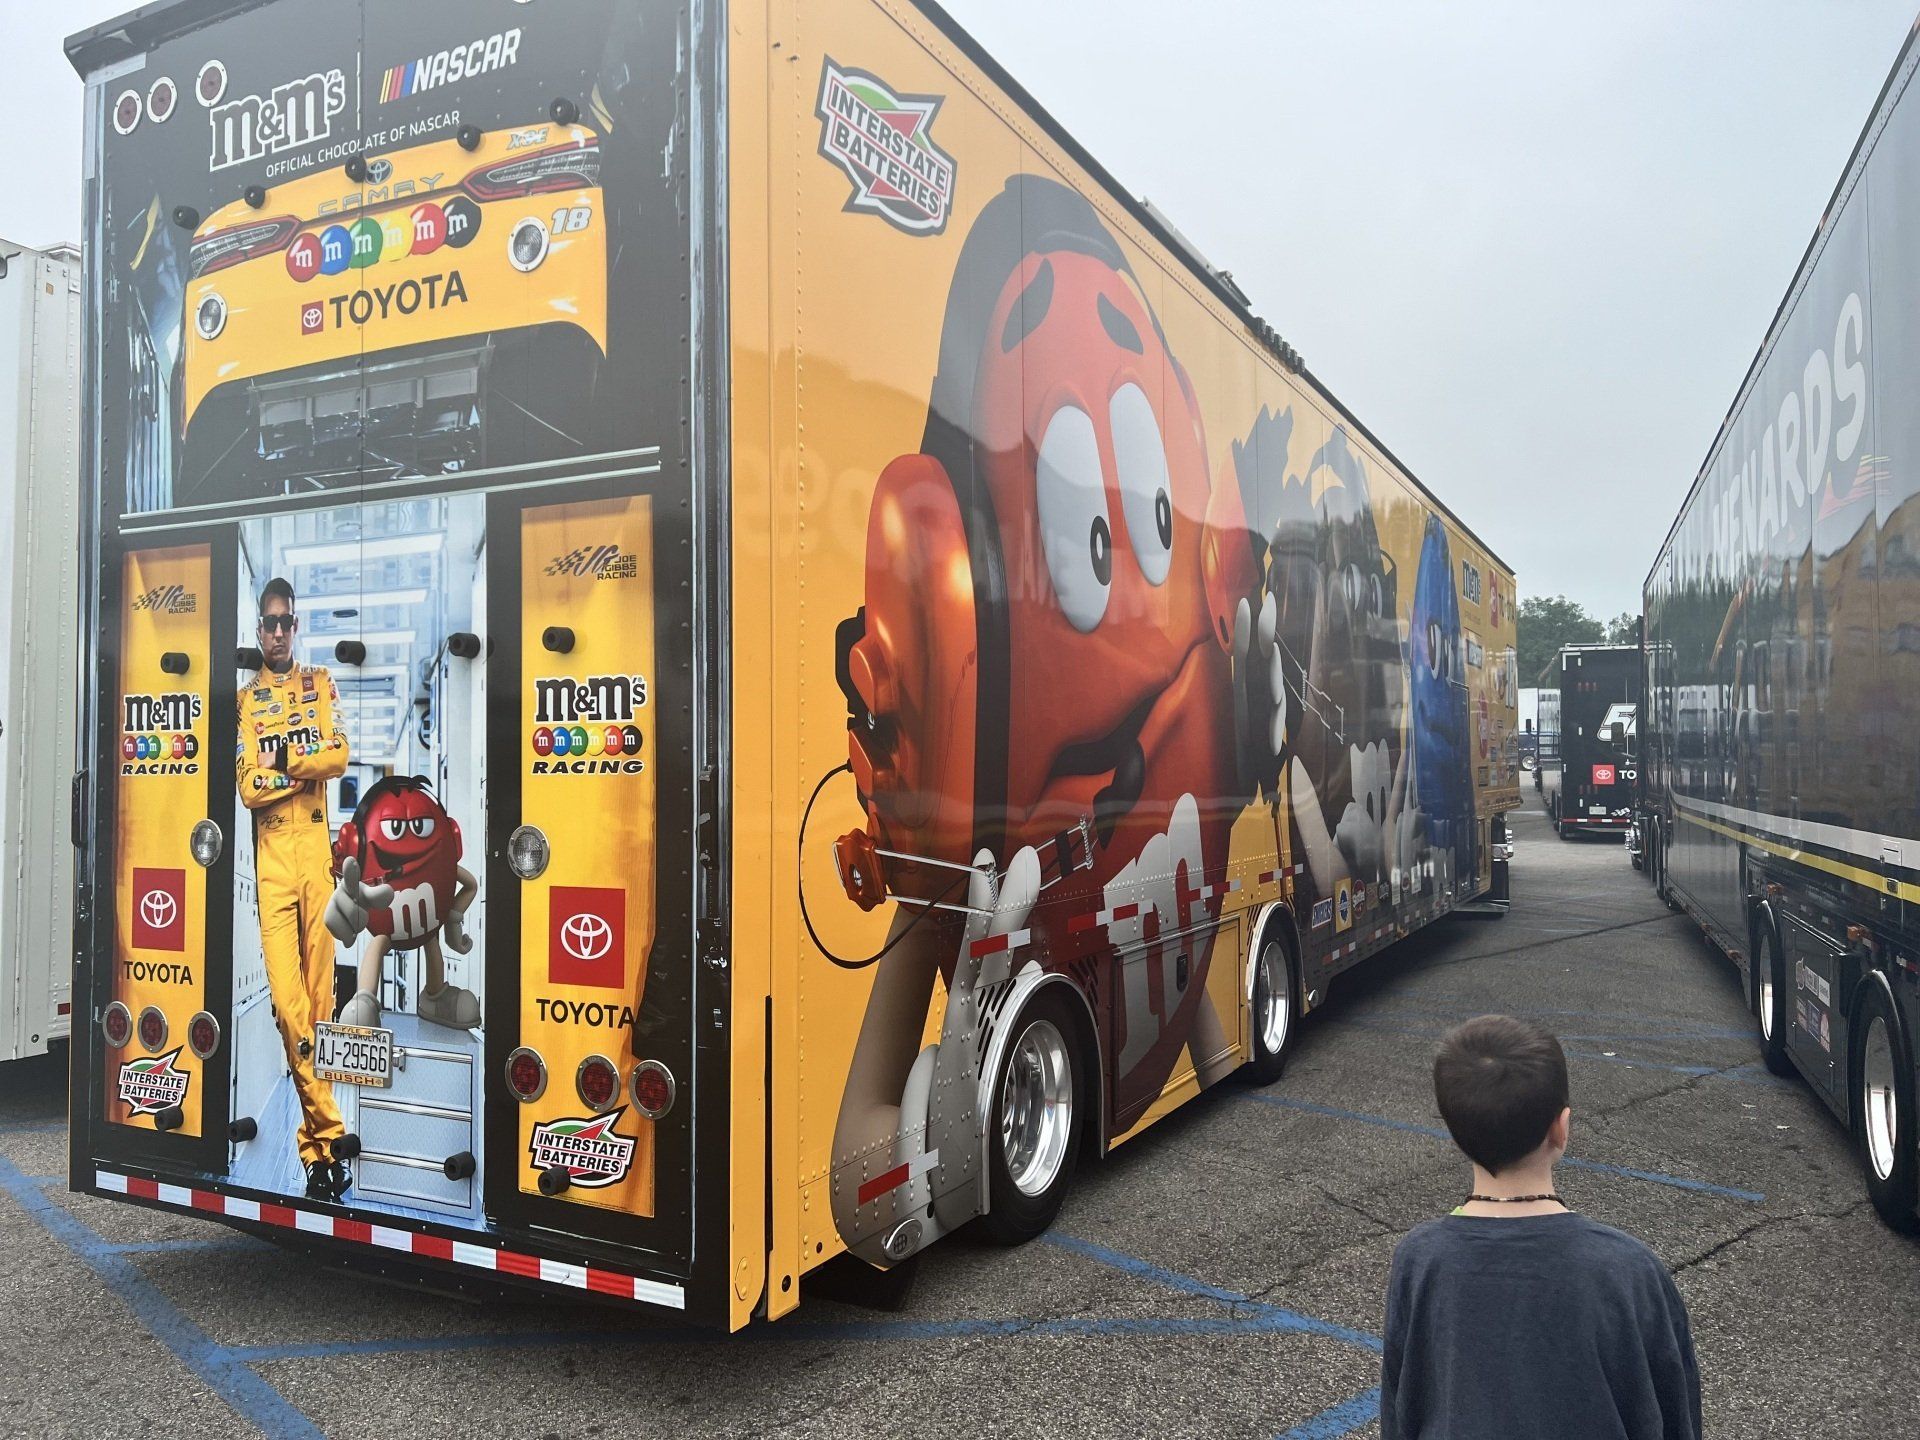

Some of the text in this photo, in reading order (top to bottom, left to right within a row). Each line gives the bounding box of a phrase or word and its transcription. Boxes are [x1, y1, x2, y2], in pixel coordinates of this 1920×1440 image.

[411, 28, 521, 94] NASCAR
[266, 110, 460, 177] OFFICIAL CHOCOLATE OF NASCAR
[831, 85, 947, 190] INTERSTATE
[835, 120, 939, 215] BATTERIES
[318, 173, 444, 216] CAMRY
[551, 206, 592, 235] 18
[329, 270, 468, 328] TOYOTA
[1712, 292, 1866, 560] MENARDS
[604, 563, 637, 572] GIBBS
[614, 554, 637, 563] JOE
[597, 571, 637, 580] RACING
[122, 763, 198, 775] RACING
[532, 760, 644, 774] RACING
[123, 960, 193, 986] TOYOTA
[536, 998, 636, 1029] TOYOTA
[318, 1037, 387, 1073] AJ-29566
[122, 1070, 183, 1089] INTERSTATE
[324, 1071, 374, 1085] BUSCH
[124, 1083, 179, 1102] BATTERIES
[538, 1132, 628, 1158] INTERSTATE
[540, 1150, 621, 1173] BATTERIES
